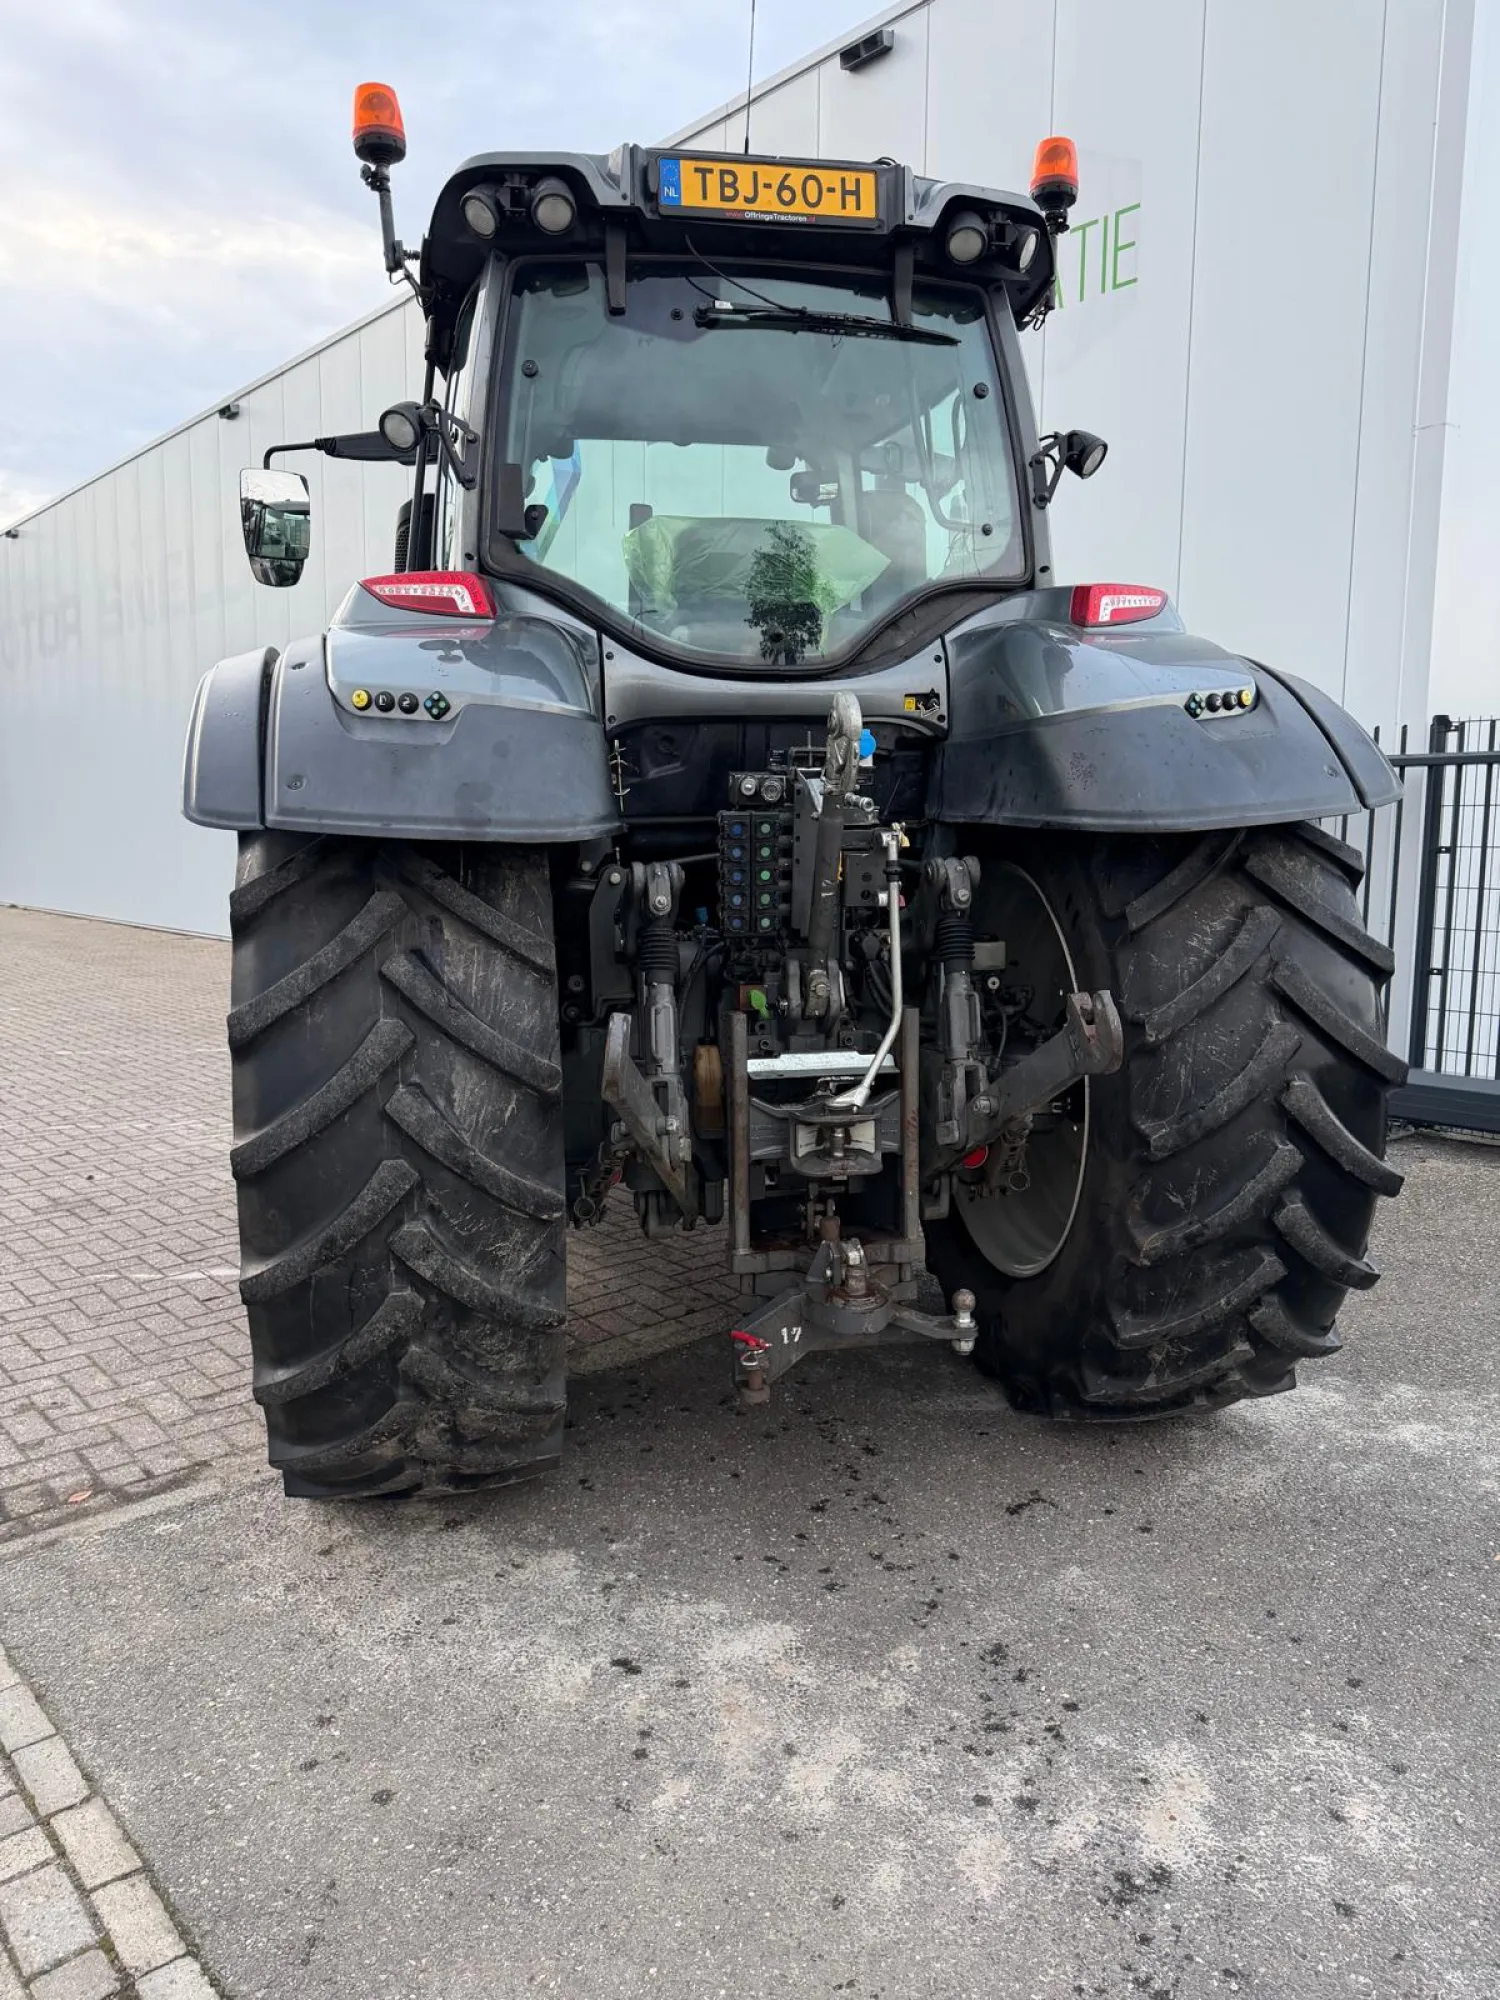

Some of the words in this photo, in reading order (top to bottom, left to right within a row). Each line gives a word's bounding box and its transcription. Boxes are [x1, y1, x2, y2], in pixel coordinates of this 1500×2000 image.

[664, 186, 679, 197] NL
[694, 167, 861, 211] TBJ-60-H
[780, 1326, 801, 1344] 17
